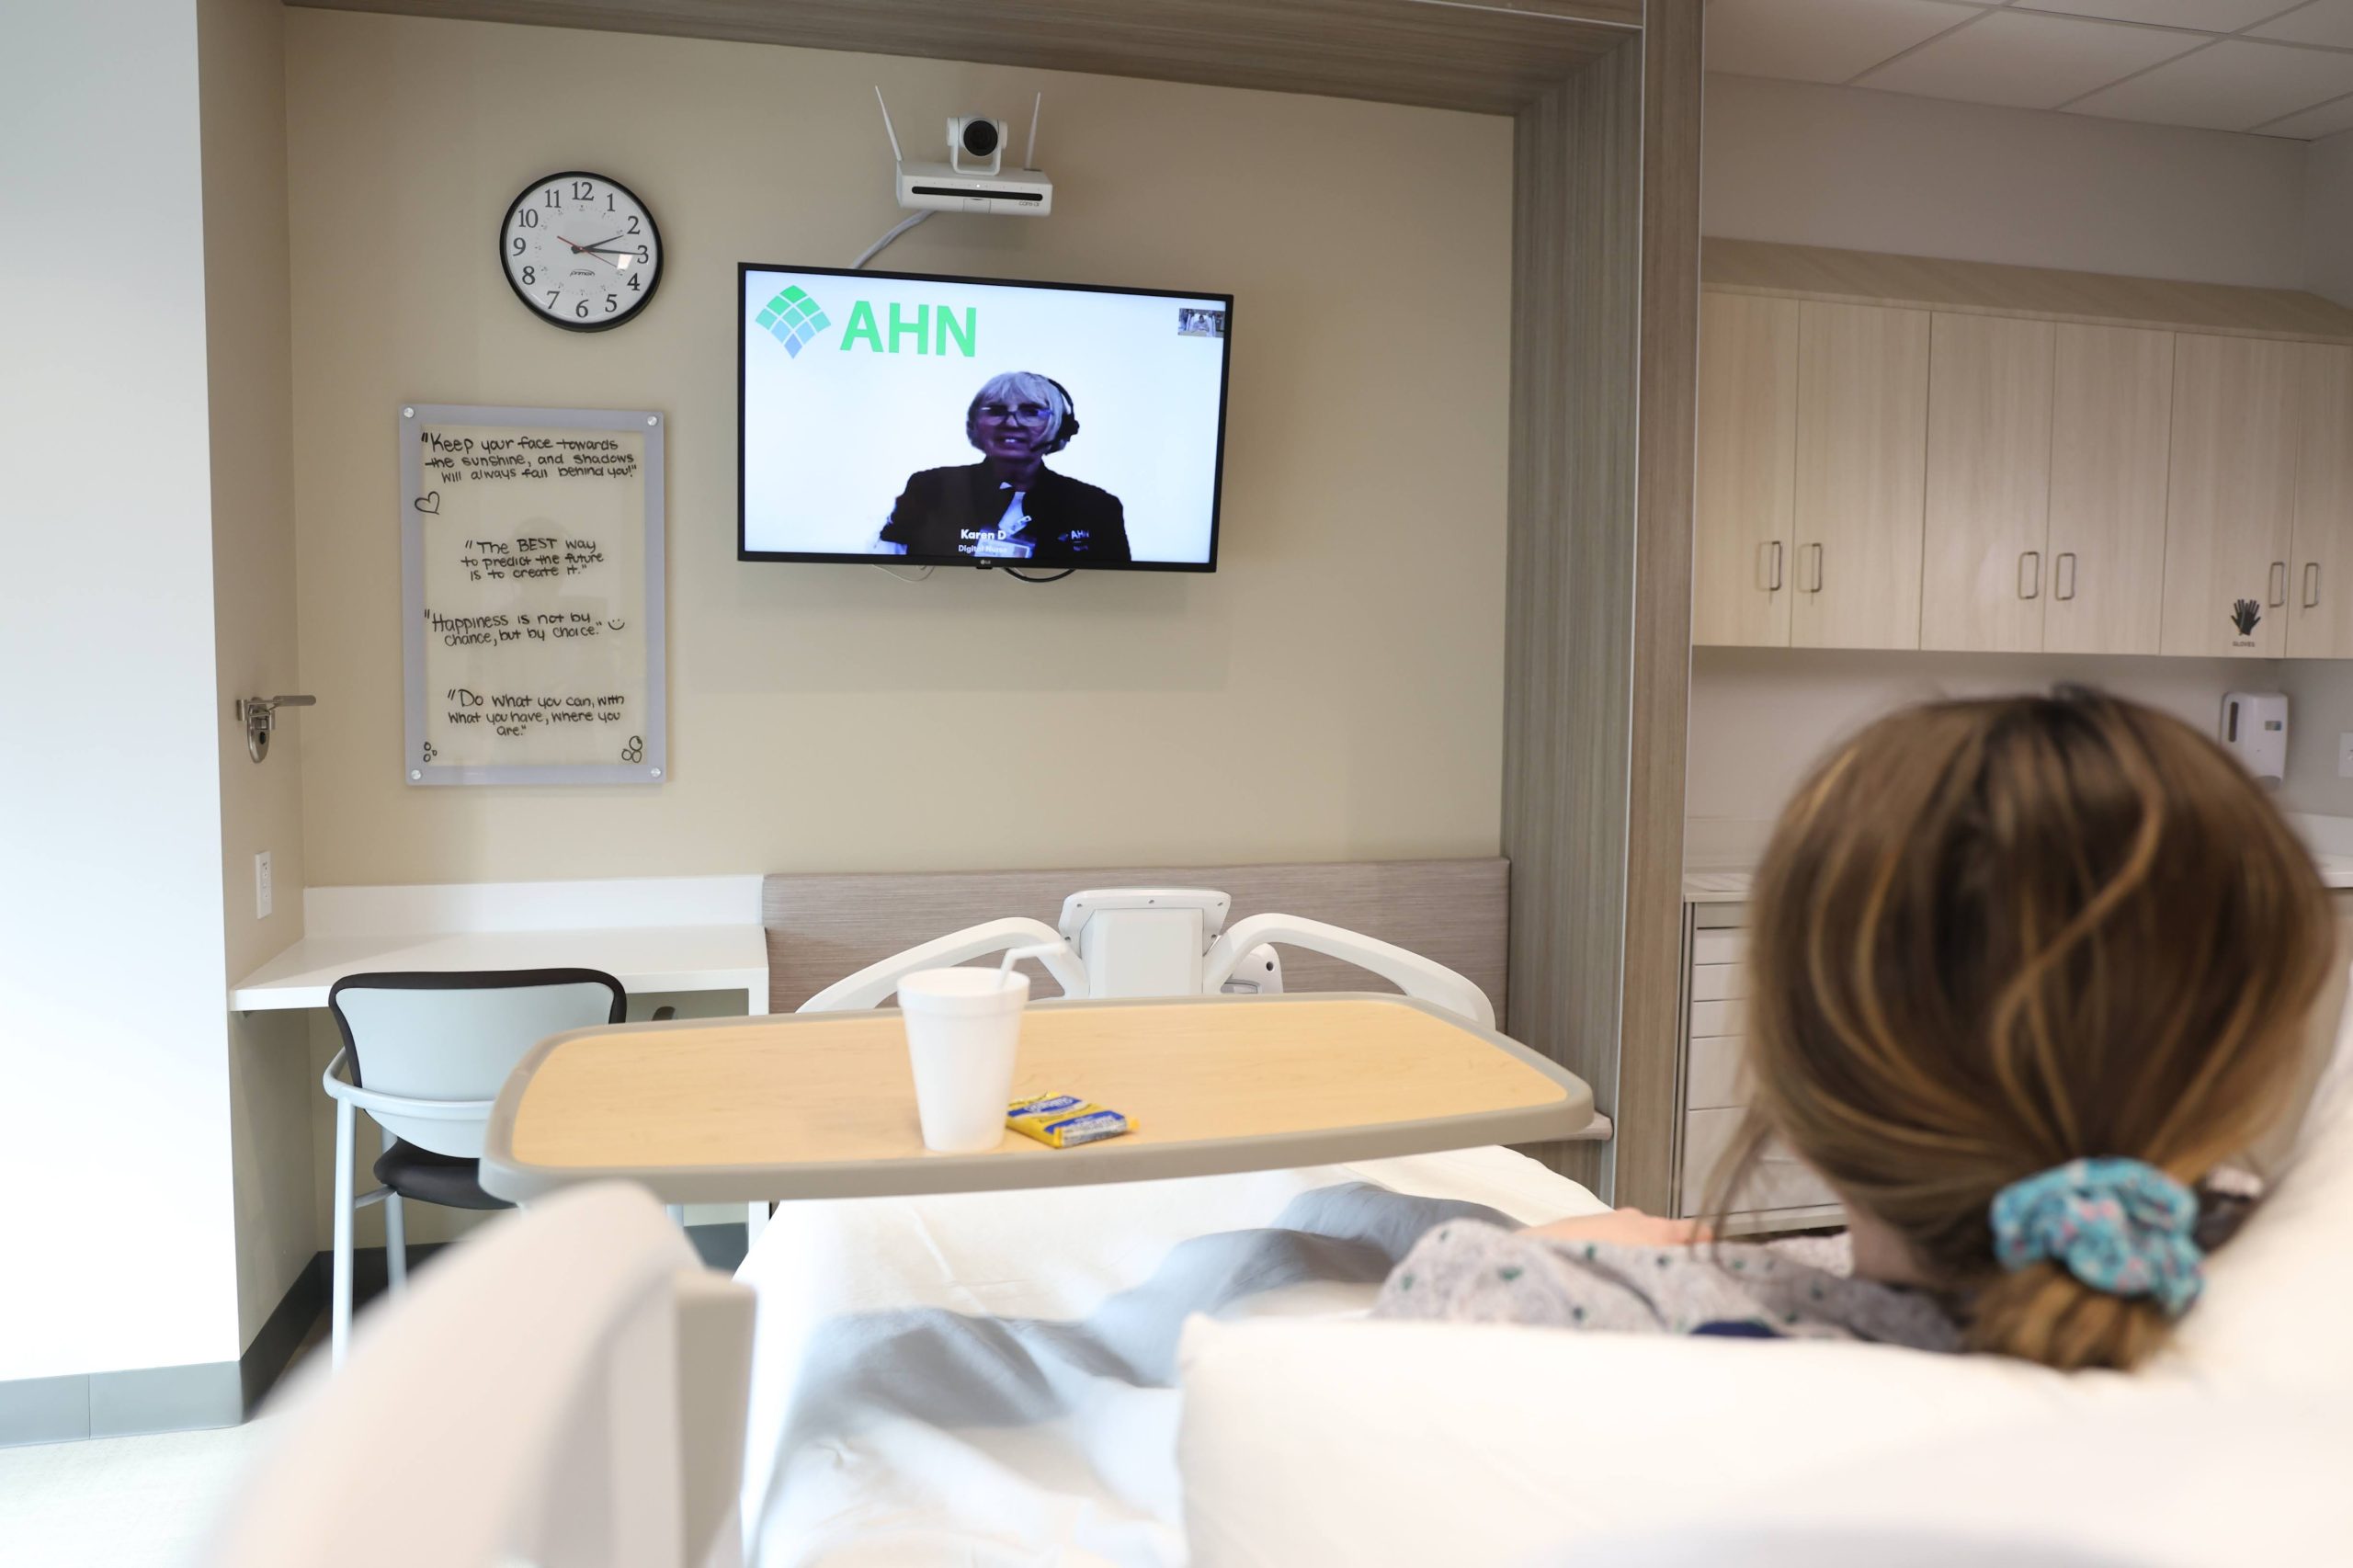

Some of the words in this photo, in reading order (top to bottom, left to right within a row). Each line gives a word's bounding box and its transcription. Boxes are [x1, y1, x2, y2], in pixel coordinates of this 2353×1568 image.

[544, 188, 562, 208] 11
[572, 181, 595, 200] 12
[607, 193, 616, 211] 1
[518, 209, 539, 228] 10
[627, 215, 641, 235] 2
[513, 237, 527, 256] 9
[637, 244, 649, 264] 3
[522, 266, 536, 285] 8
[627, 272, 641, 291] 4
[546, 290, 561, 310] 7
[575, 299, 589, 318] 6
[605, 293, 618, 312] 5
[839, 300, 976, 358] AHN
[421, 432, 473, 454] "Keep
[481, 440, 514, 454] your
[517, 436, 553, 449] face
[556, 439, 619, 451] towards
[425, 457, 455, 468] the
[461, 454, 531, 468] sunshine,
[538, 453, 564, 465] and
[573, 453, 634, 464] shadows
[471, 468, 517, 480] always
[521, 468, 548, 478] fall
[558, 466, 604, 477] behind
[961, 529, 995, 540] Karen
[997, 529, 1006, 540] D
[465, 540, 510, 554] "The
[517, 538, 558, 552] BEST
[958, 544, 983, 554] Digital
[460, 556, 479, 567] to
[482, 556, 531, 570] predict
[535, 554, 561, 565] the
[565, 552, 605, 563] future
[470, 571, 482, 582] is
[487, 568, 505, 579] to
[513, 567, 559, 578] create
[424, 608, 509, 634] "Happiness
[517, 614, 529, 625] is
[538, 614, 564, 625] not
[570, 612, 591, 623] by
[499, 630, 521, 642] but
[527, 628, 546, 642] by
[448, 688, 483, 707] "Do
[537, 696, 562, 710] you
[566, 696, 595, 708] can,
[597, 694, 625, 706] with
[486, 712, 507, 725] you
[510, 710, 549, 725] have,
[597, 711, 621, 723] you
[496, 724, 527, 736] are."
